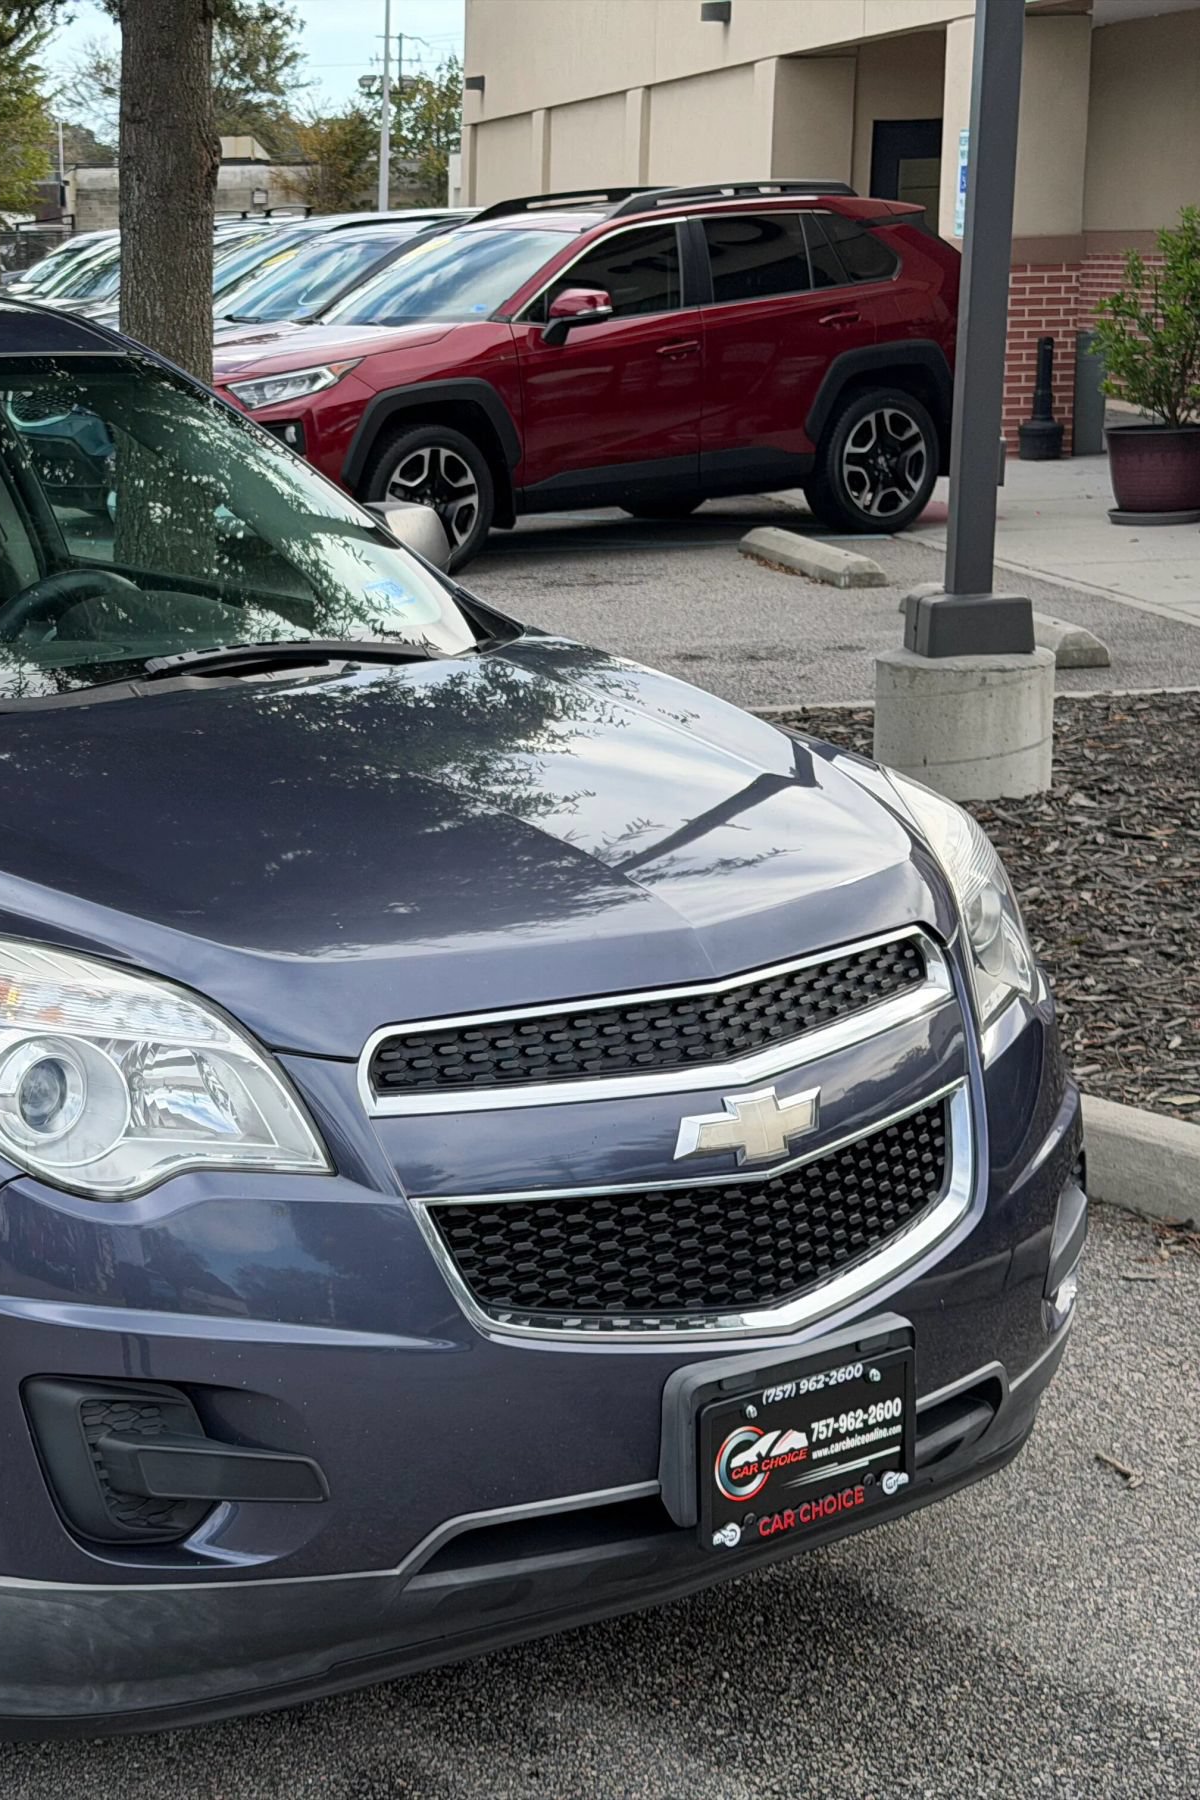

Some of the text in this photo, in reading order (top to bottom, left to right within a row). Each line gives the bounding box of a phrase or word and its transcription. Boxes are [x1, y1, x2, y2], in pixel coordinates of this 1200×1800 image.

[762, 1363, 863, 1405] (757) 962-2600
[811, 1397, 902, 1443] 757-962-2600
[812, 1425, 902, 1460] www.carchoiceonline.com
[731, 1448, 808, 1480] CAR CHOICE
[758, 1485, 865, 1537] CAR CHOICE
